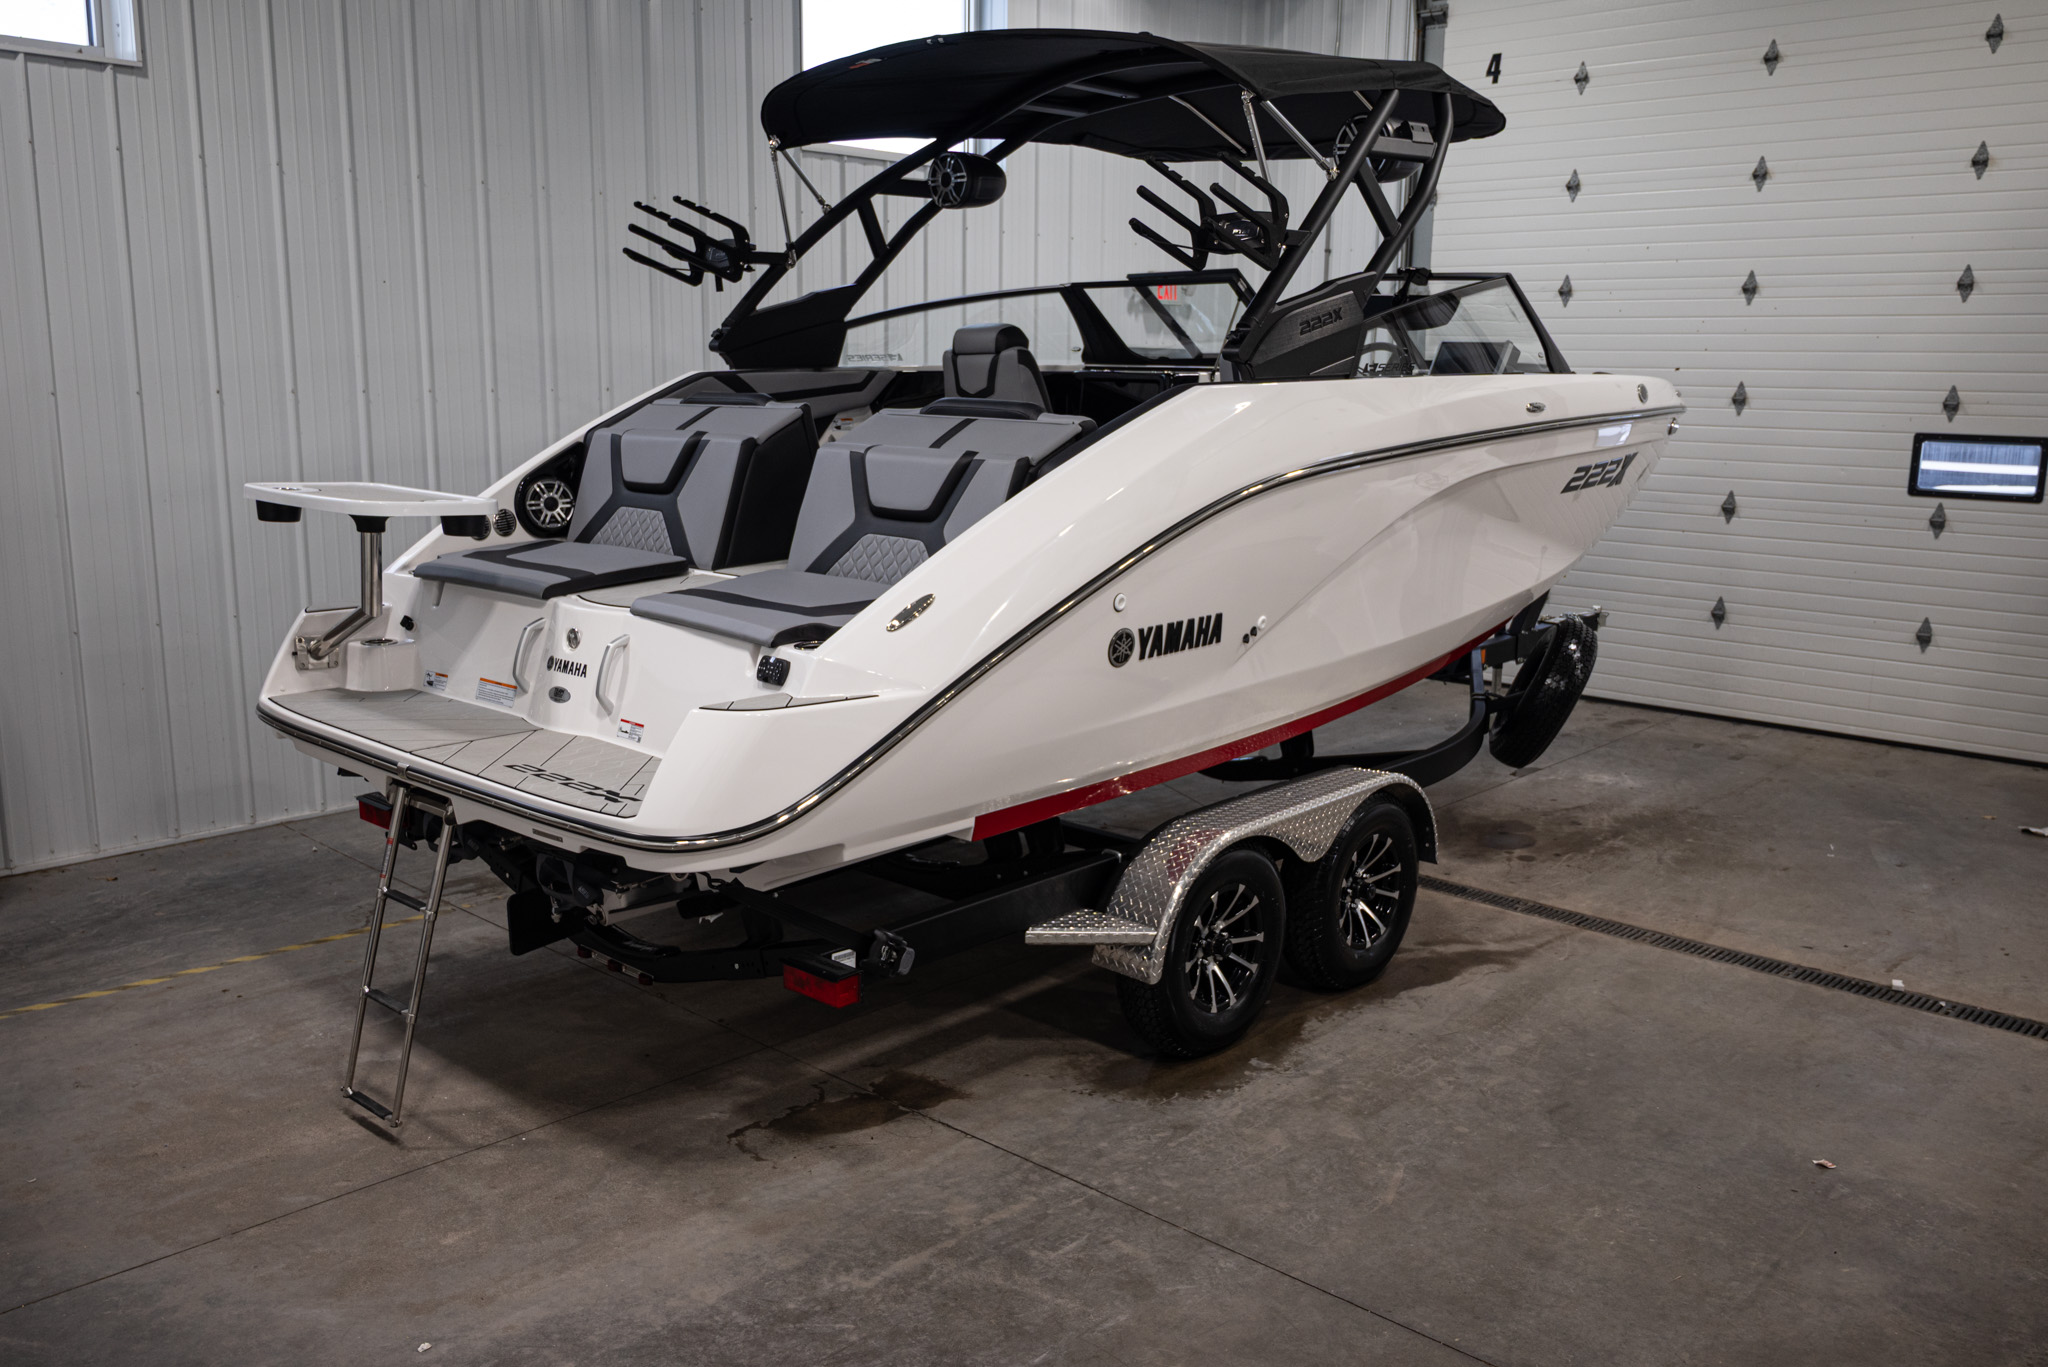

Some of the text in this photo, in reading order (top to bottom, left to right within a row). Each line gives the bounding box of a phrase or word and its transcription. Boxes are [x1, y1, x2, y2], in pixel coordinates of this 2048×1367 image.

[1486, 53, 1502, 84] 4
[1300, 307, 1343, 336] 222X
[1560, 452, 1639, 494] 222X
[1138, 612, 1223, 660] YAMAHA
[553, 657, 588, 678] YAMAHA
[503, 763, 643, 803] 222X
